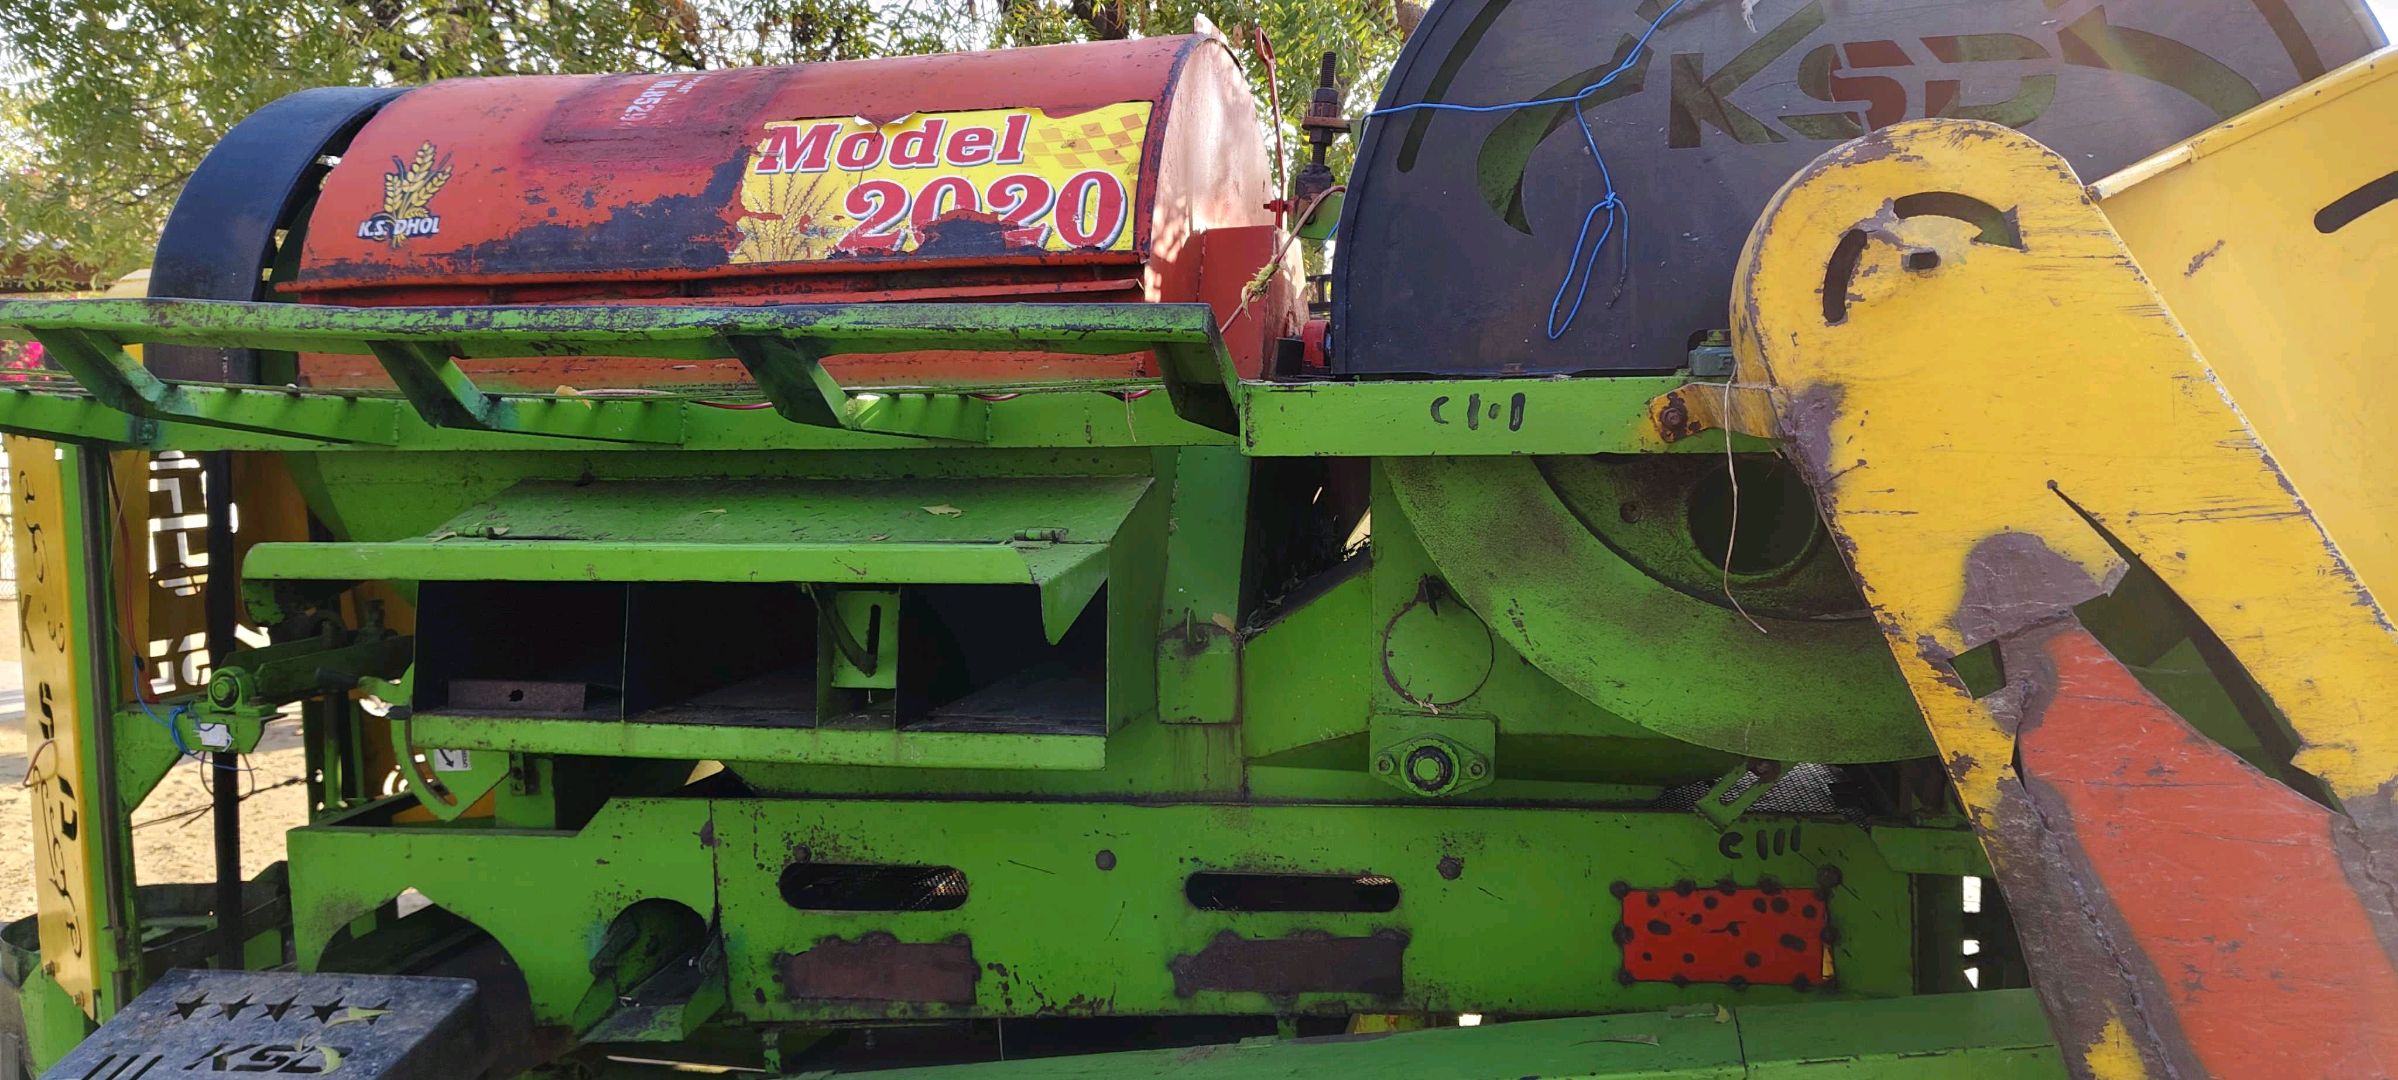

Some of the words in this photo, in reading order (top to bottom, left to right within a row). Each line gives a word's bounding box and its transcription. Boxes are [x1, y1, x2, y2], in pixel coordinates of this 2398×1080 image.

[1669, 1, 2056, 149] KSD
[755, 113, 1032, 175] Model
[393, 217, 440, 236] DHOL
[836, 171, 1127, 252] 2020
